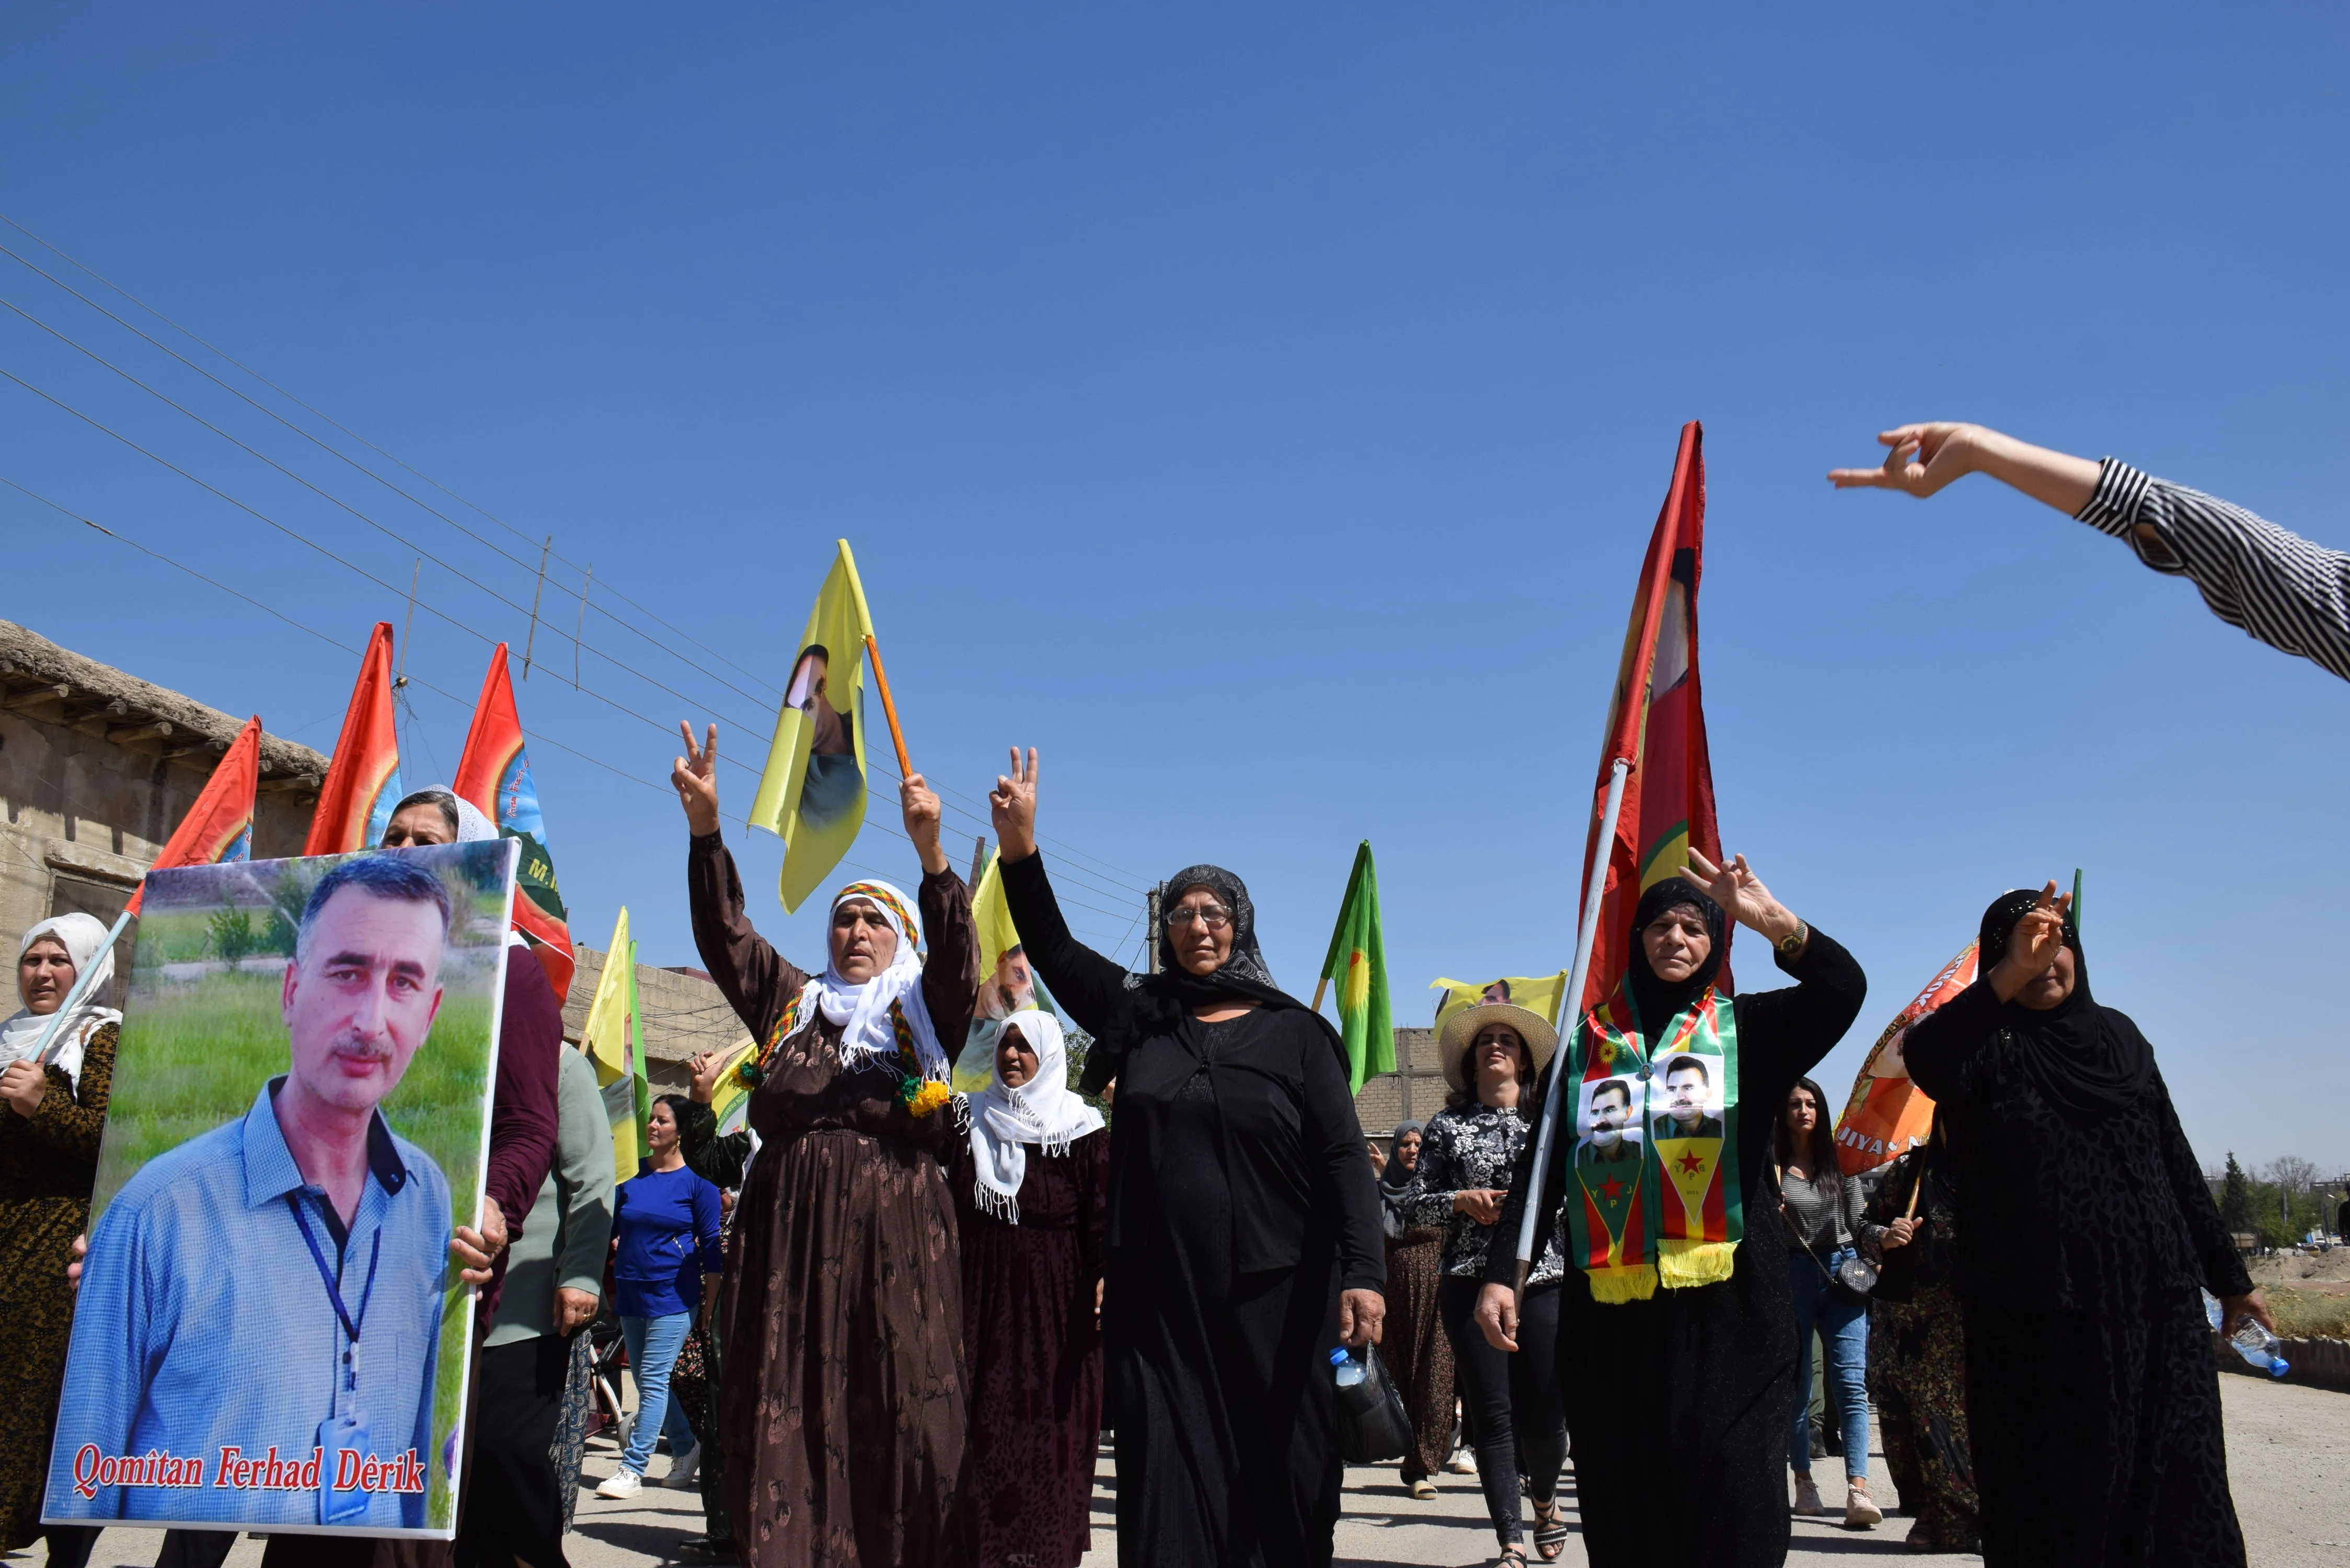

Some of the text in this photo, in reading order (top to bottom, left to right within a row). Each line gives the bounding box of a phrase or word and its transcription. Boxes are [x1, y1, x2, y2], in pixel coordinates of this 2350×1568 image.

[1837, 1126, 1900, 1155] JIYAN
[1674, 1163, 1682, 1173] Y
[1592, 1185, 1632, 1208] Y P J
[74, 1443, 425, 1500] Qomîtan Ferhad Dêrik
